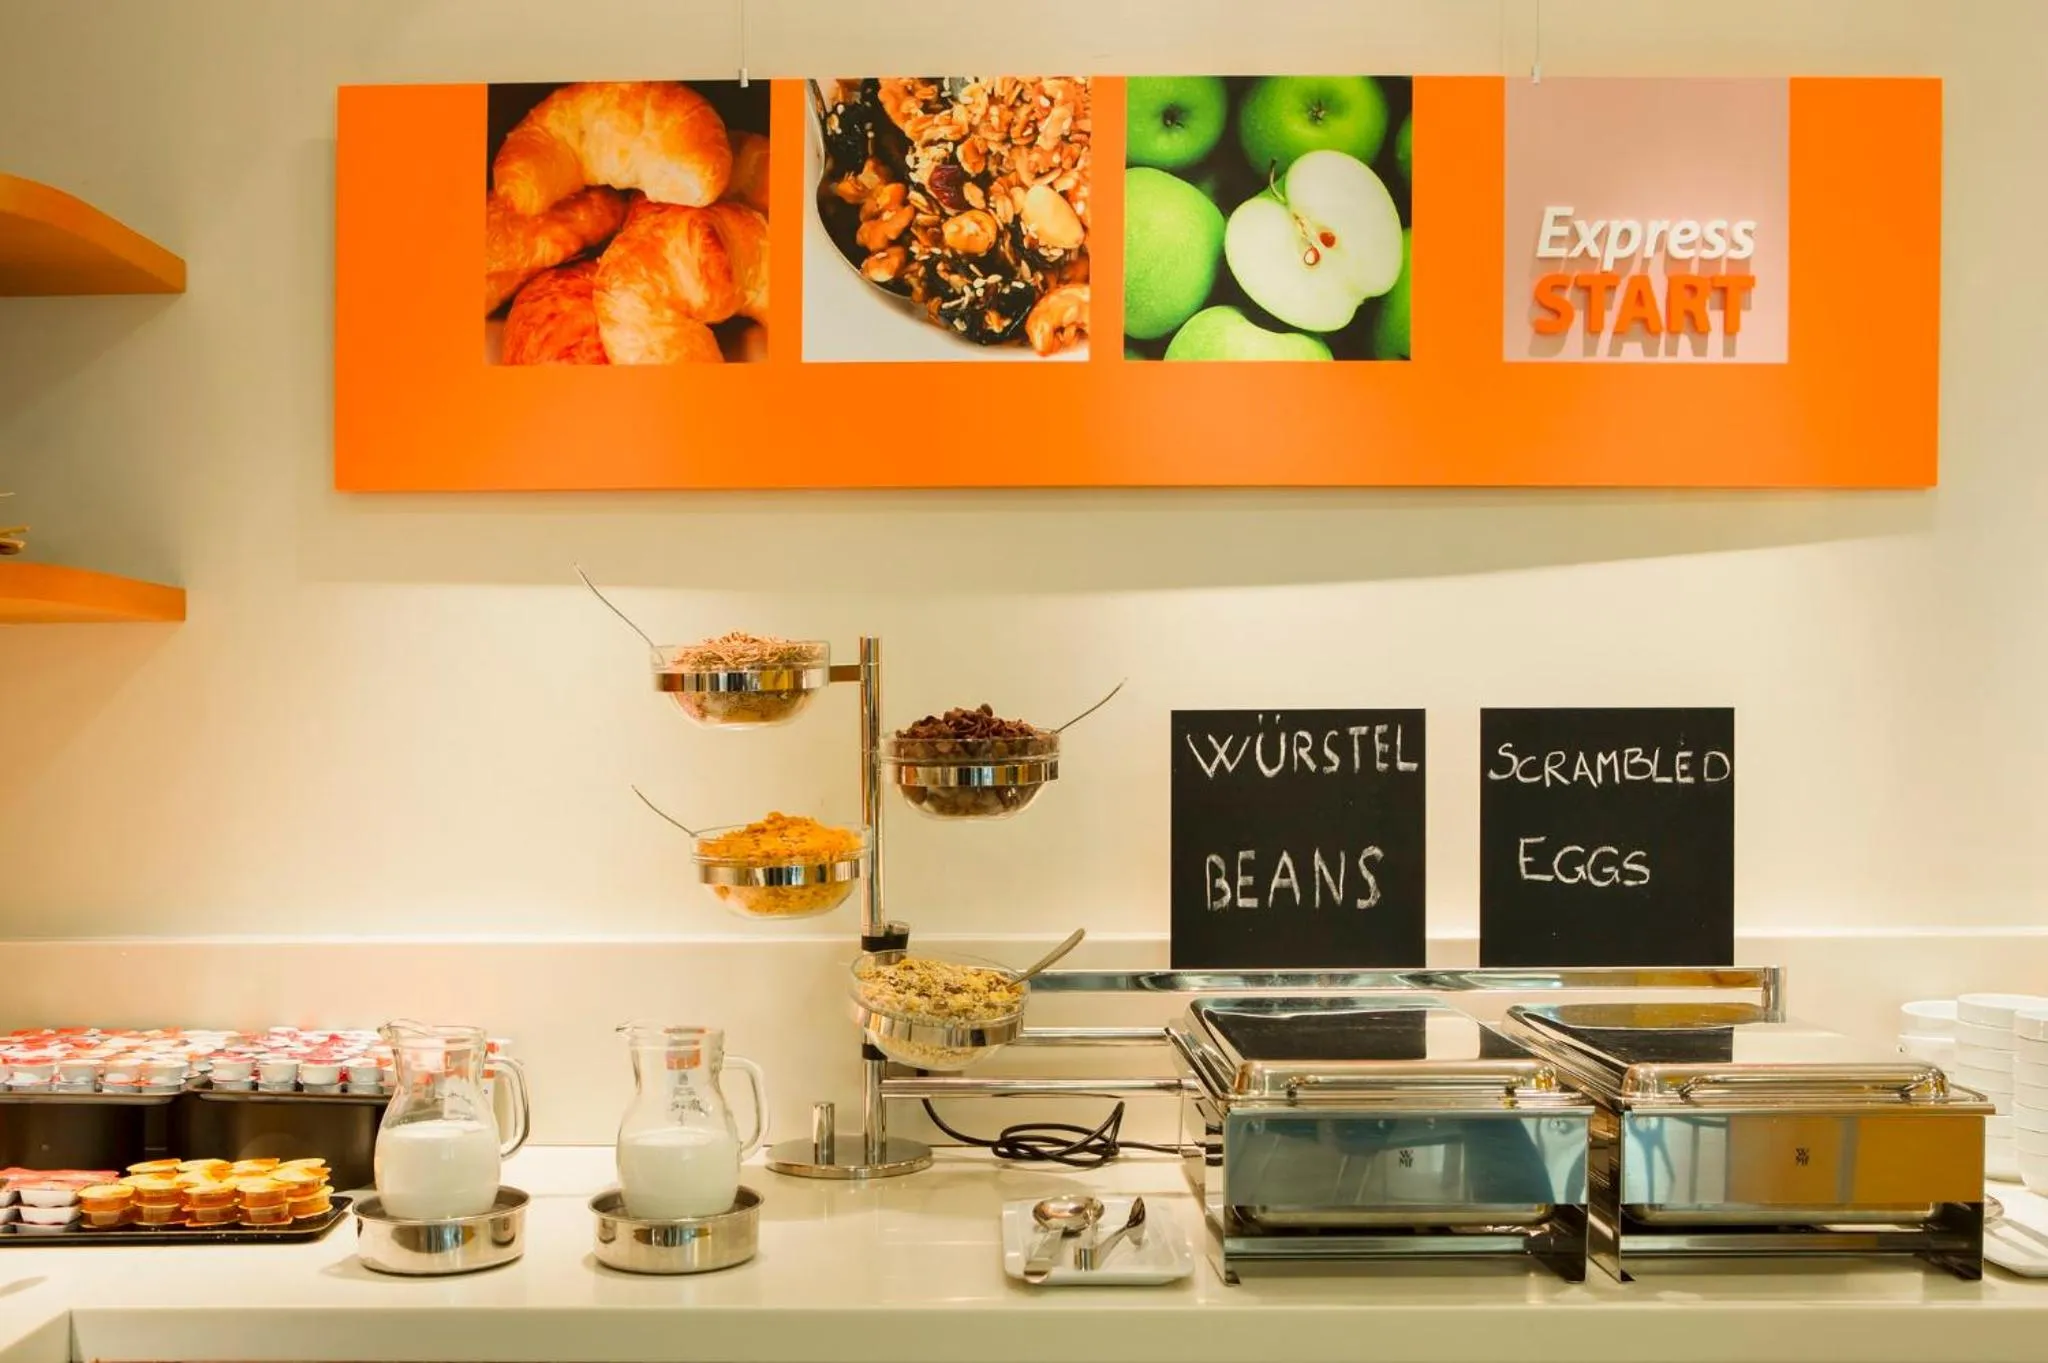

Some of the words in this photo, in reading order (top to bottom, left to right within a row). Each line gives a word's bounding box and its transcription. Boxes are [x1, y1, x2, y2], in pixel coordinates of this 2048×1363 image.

[1536, 205, 1757, 272] Express
[1533, 273, 1755, 336] START
[1186, 714, 1419, 779] WÜRSTEL
[1205, 845, 1384, 911] BEANS
[1518, 835, 1652, 888] EGGS
